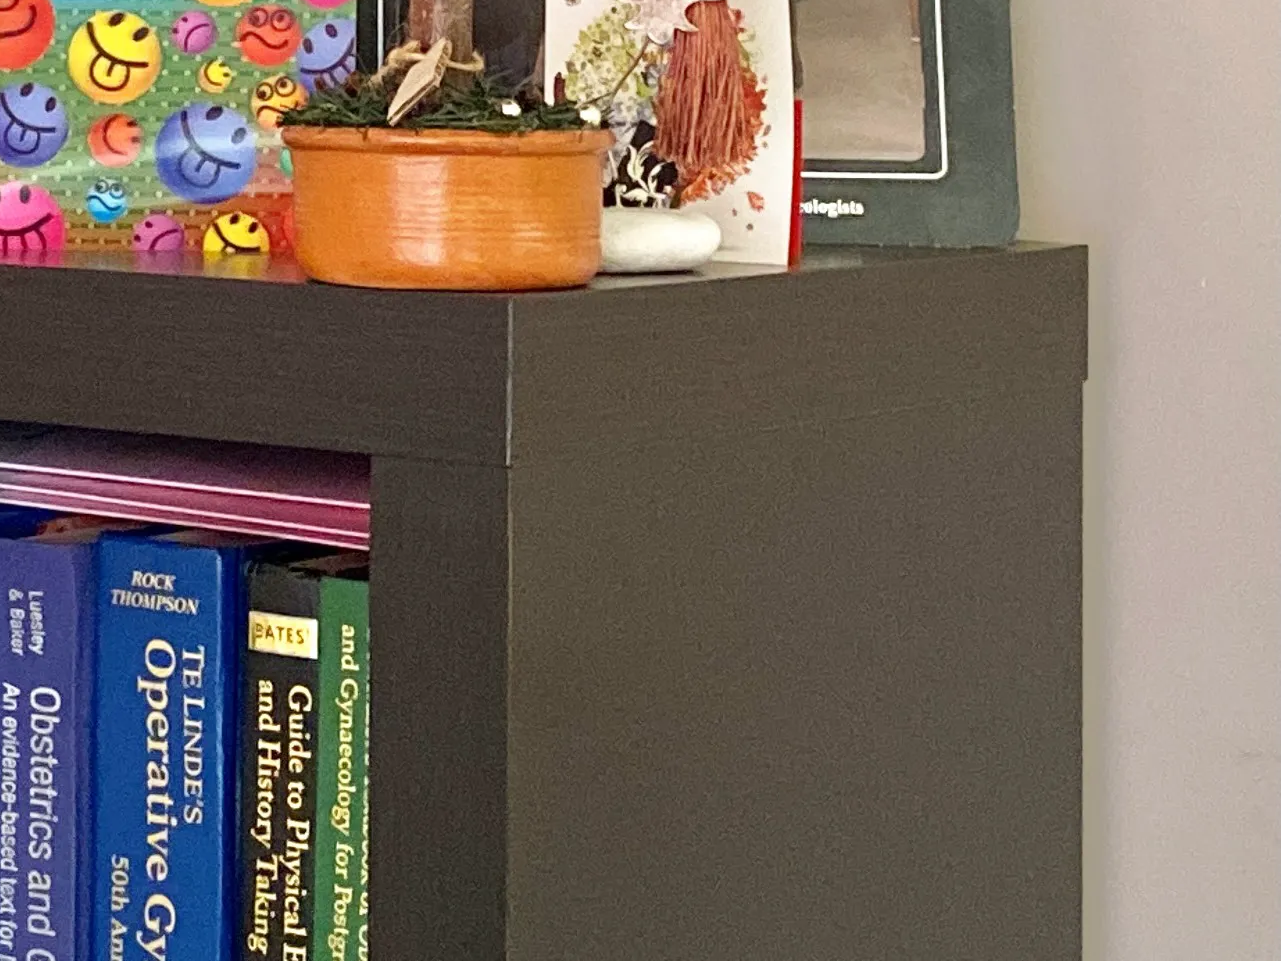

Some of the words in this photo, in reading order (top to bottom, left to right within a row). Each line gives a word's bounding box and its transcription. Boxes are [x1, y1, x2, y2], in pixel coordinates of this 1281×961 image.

[110, 588, 201, 616] THOMPSON
[130, 569, 177, 591] ROCK
[8, 608, 25, 656] Baker
[25, 590, 46, 655] Luesley
[340, 624, 360, 671] and
[1, 683, 22, 712] An
[258, 680, 280, 732] and
[287, 685, 313, 773] Guide
[29, 686, 61, 860] Obstetrics
[135, 638, 180, 882] Operative
[331, 678, 359, 836] Gynaecology
[0, 716, 21, 870] evidence-based
[250, 739, 280, 850] History
[287, 782, 308, 809] to
[109, 854, 130, 911] 50th
[278, 818, 310, 936] Physical
[334, 842, 354, 879] for
[27, 870, 57, 937] and
[247, 854, 278, 955] Taking
